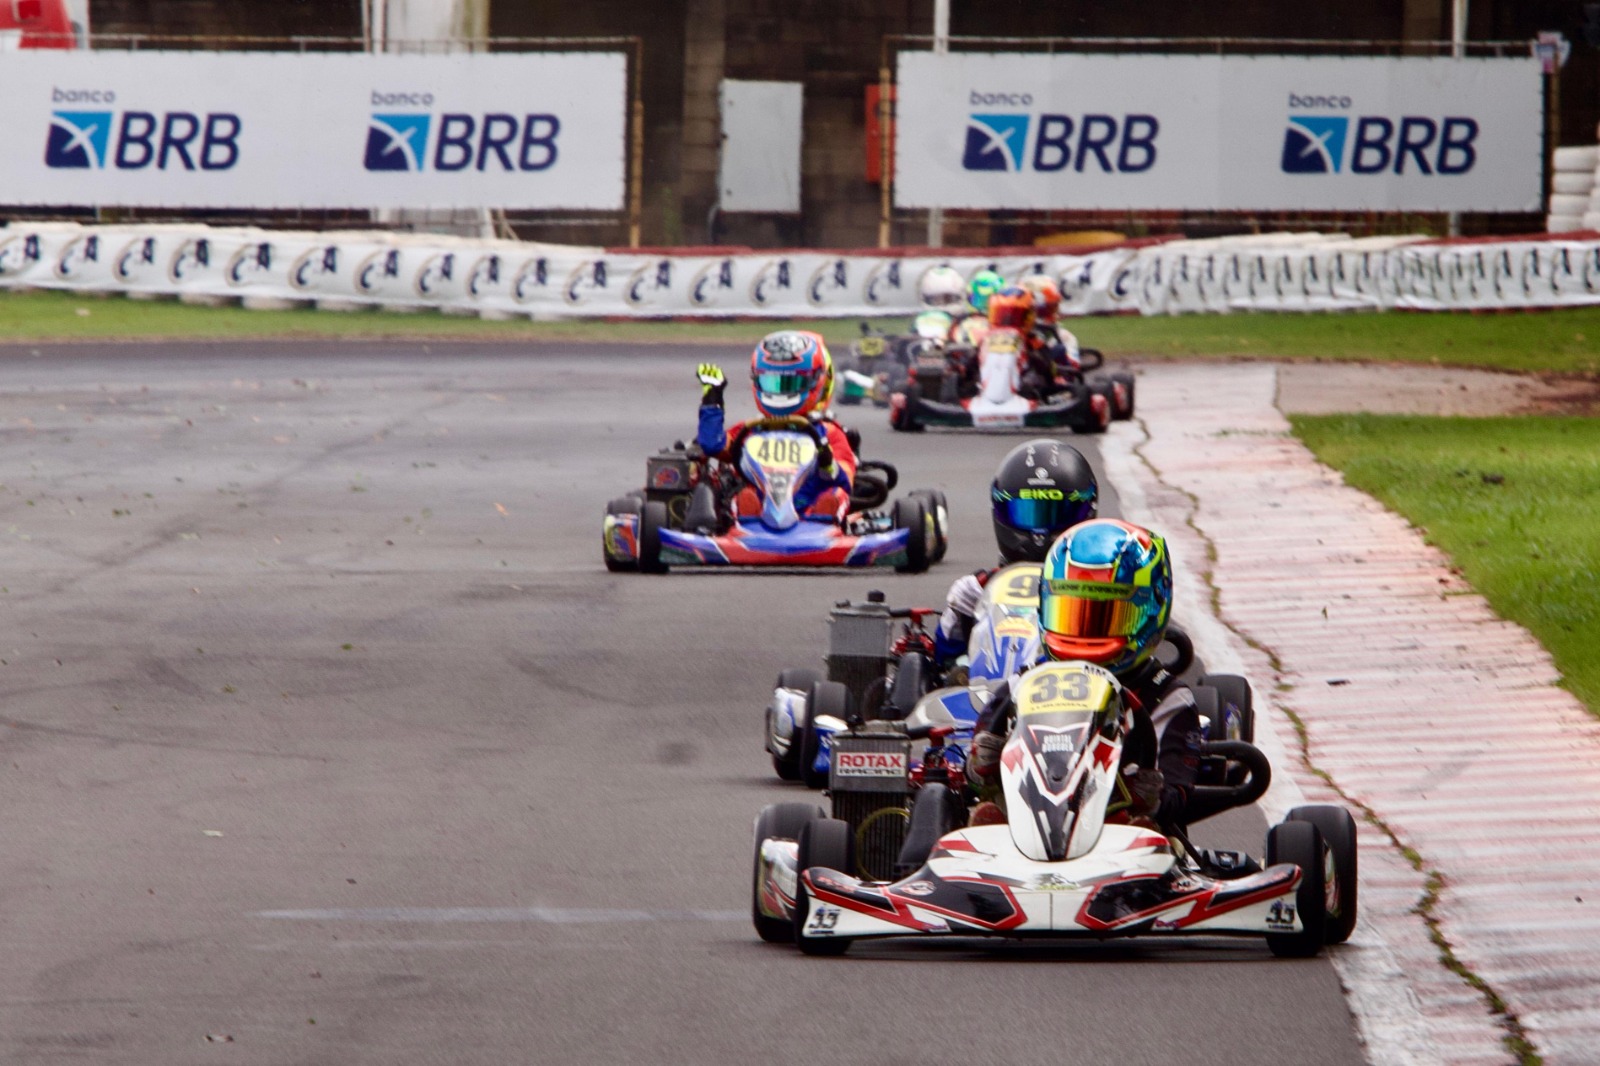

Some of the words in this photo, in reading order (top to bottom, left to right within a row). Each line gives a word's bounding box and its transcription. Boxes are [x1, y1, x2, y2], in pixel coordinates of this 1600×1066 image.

[52, 88, 115, 103] banco
[371, 91, 433, 105] banco
[970, 91, 1033, 105] banco
[1289, 93, 1352, 108] banco
[114, 111, 241, 171] BRB
[433, 113, 560, 172] BRB
[1033, 114, 1159, 173] BRB
[1351, 116, 1479, 175] BRB
[757, 438, 801, 464] 408
[1018, 488, 1064, 500] EIKO
[1006, 575, 1041, 599] 9
[1030, 672, 1091, 704] 33
[839, 754, 903, 768] ROTAX
[808, 911, 840, 929] 33
[1265, 904, 1295, 923] 33
